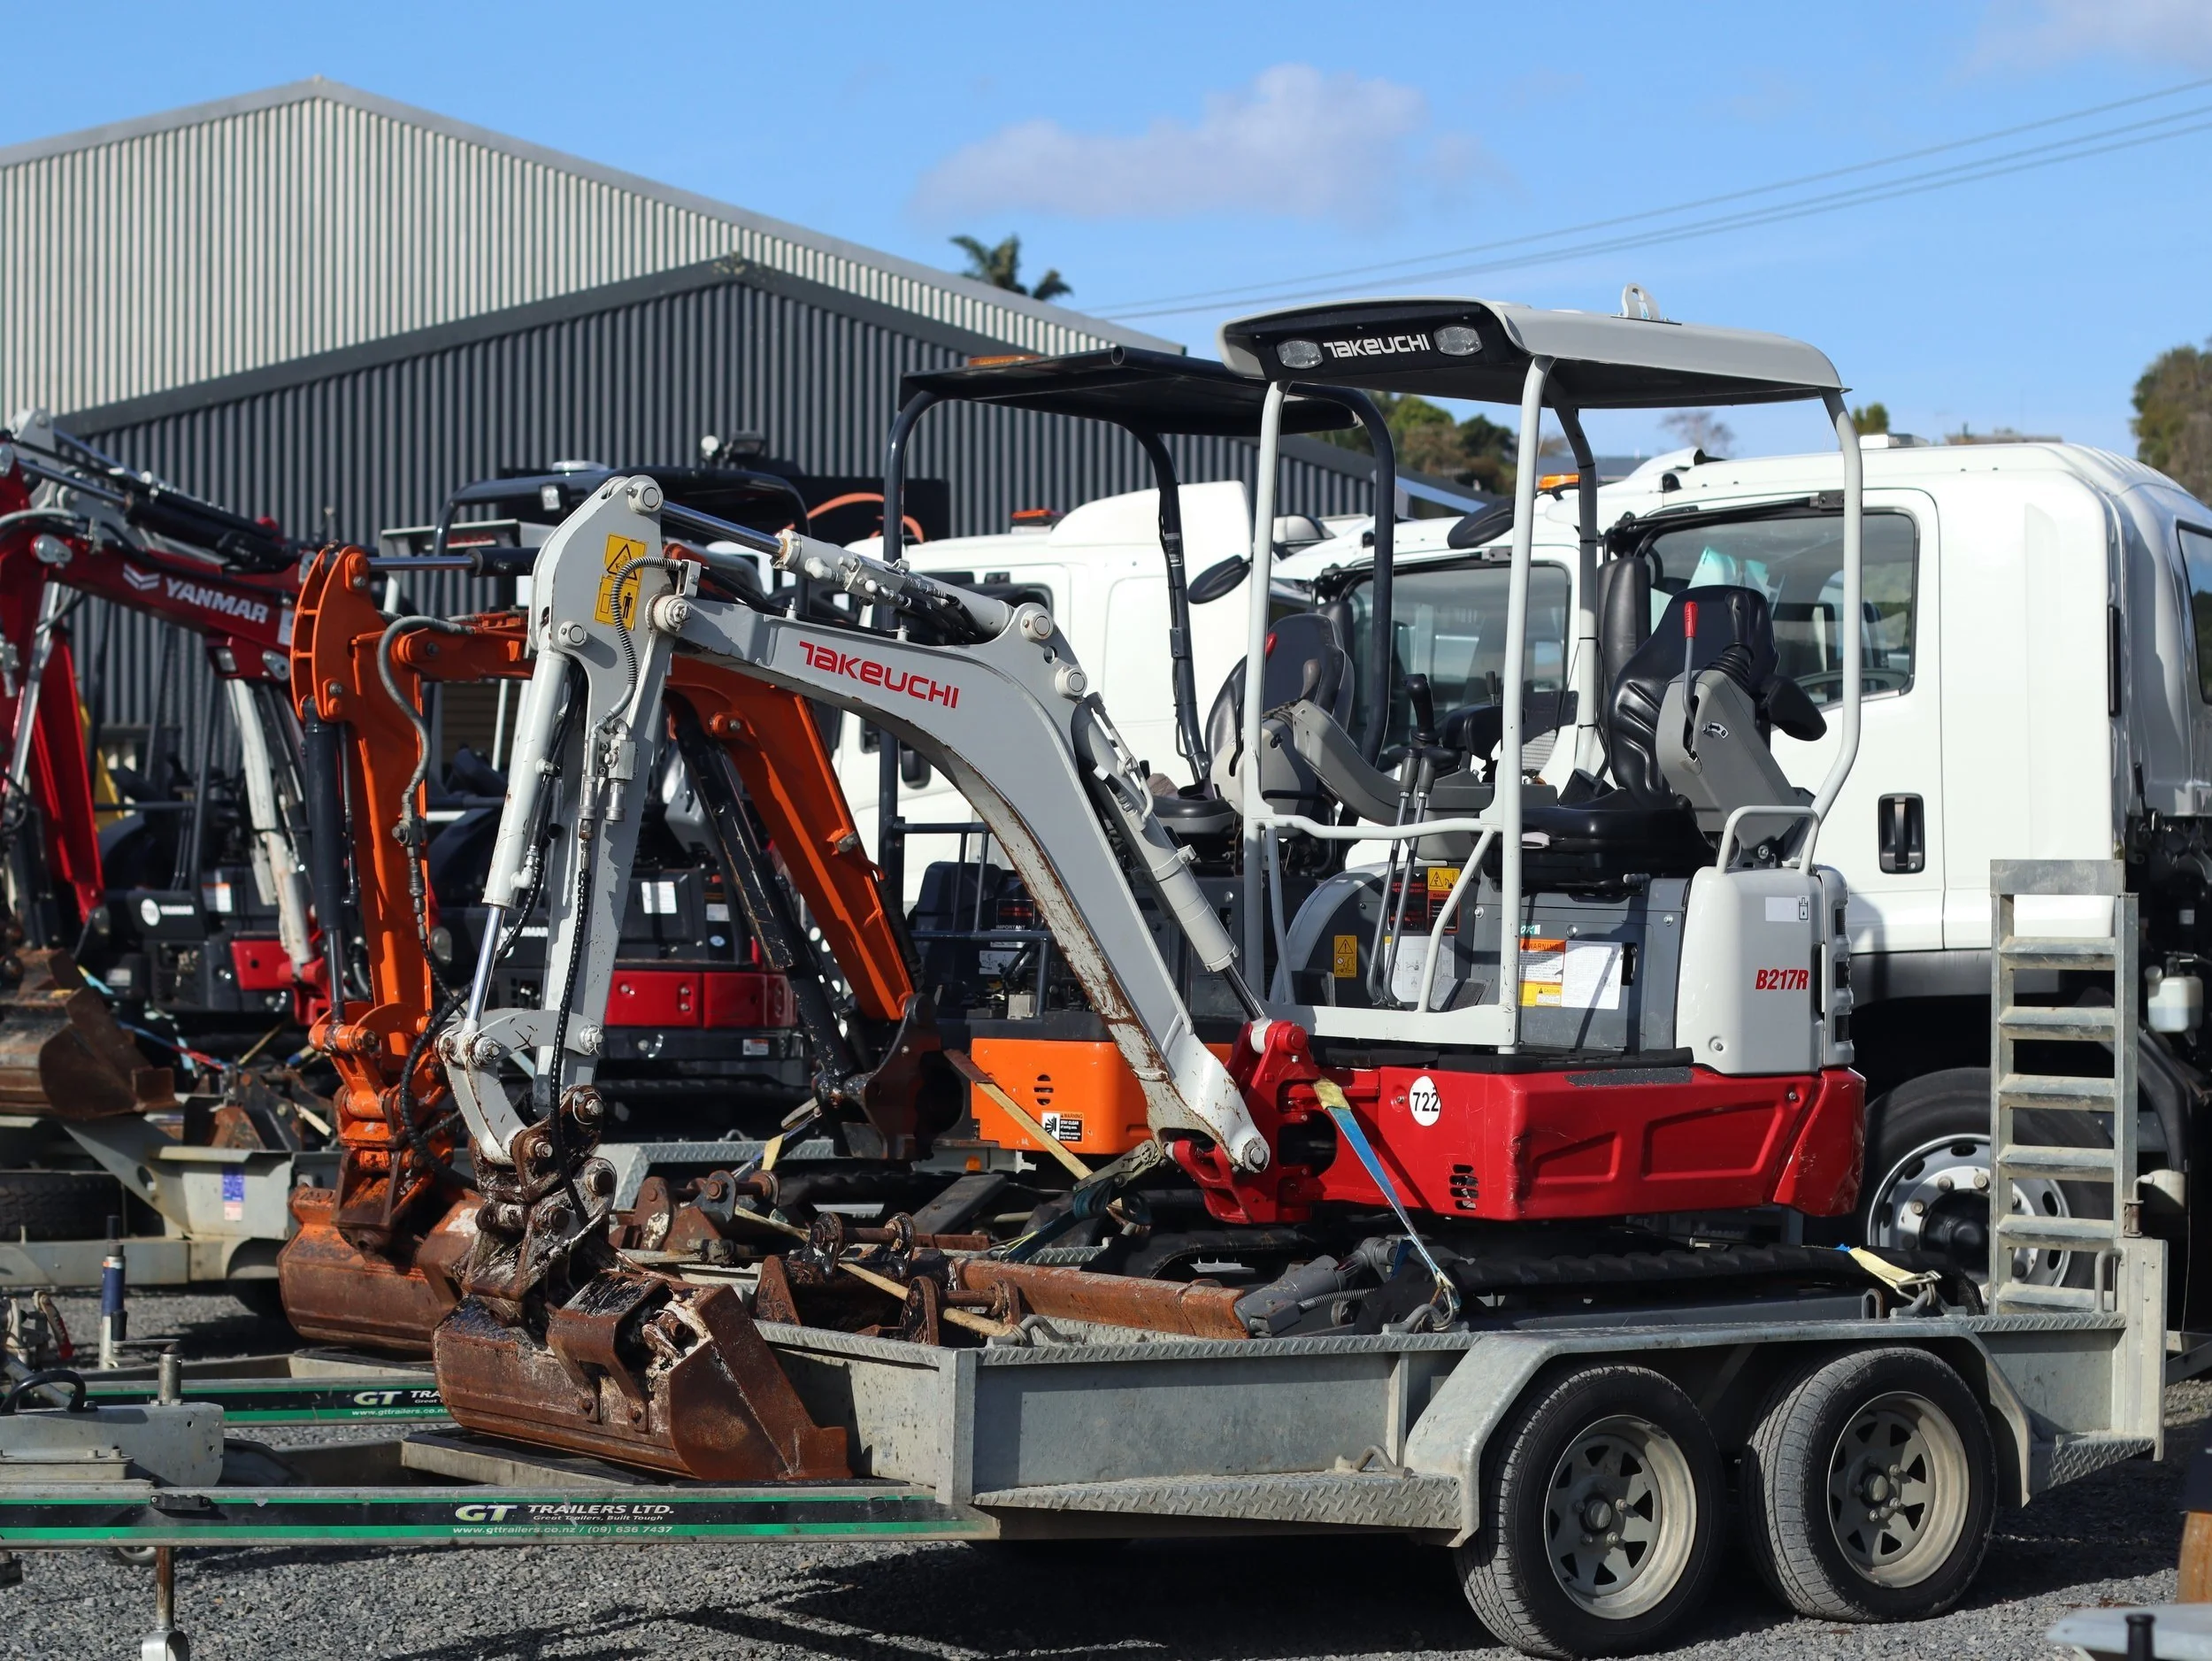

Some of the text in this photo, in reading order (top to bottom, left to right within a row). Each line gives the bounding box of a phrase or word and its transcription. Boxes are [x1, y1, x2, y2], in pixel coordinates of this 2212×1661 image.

[165, 577, 269, 624] YANMAR
[1529, 942, 1559, 951] WARNING
[1755, 968, 1809, 990] B217R
[1412, 1091, 1440, 1112] 722
[353, 1391, 403, 1406] GT
[455, 1504, 518, 1522] GT
[527, 1504, 675, 1514] TRAILERS LTD.
[453, 1526, 576, 1534] www.gttrailers.co.nz
[588, 1526, 612, 1534] (09)
